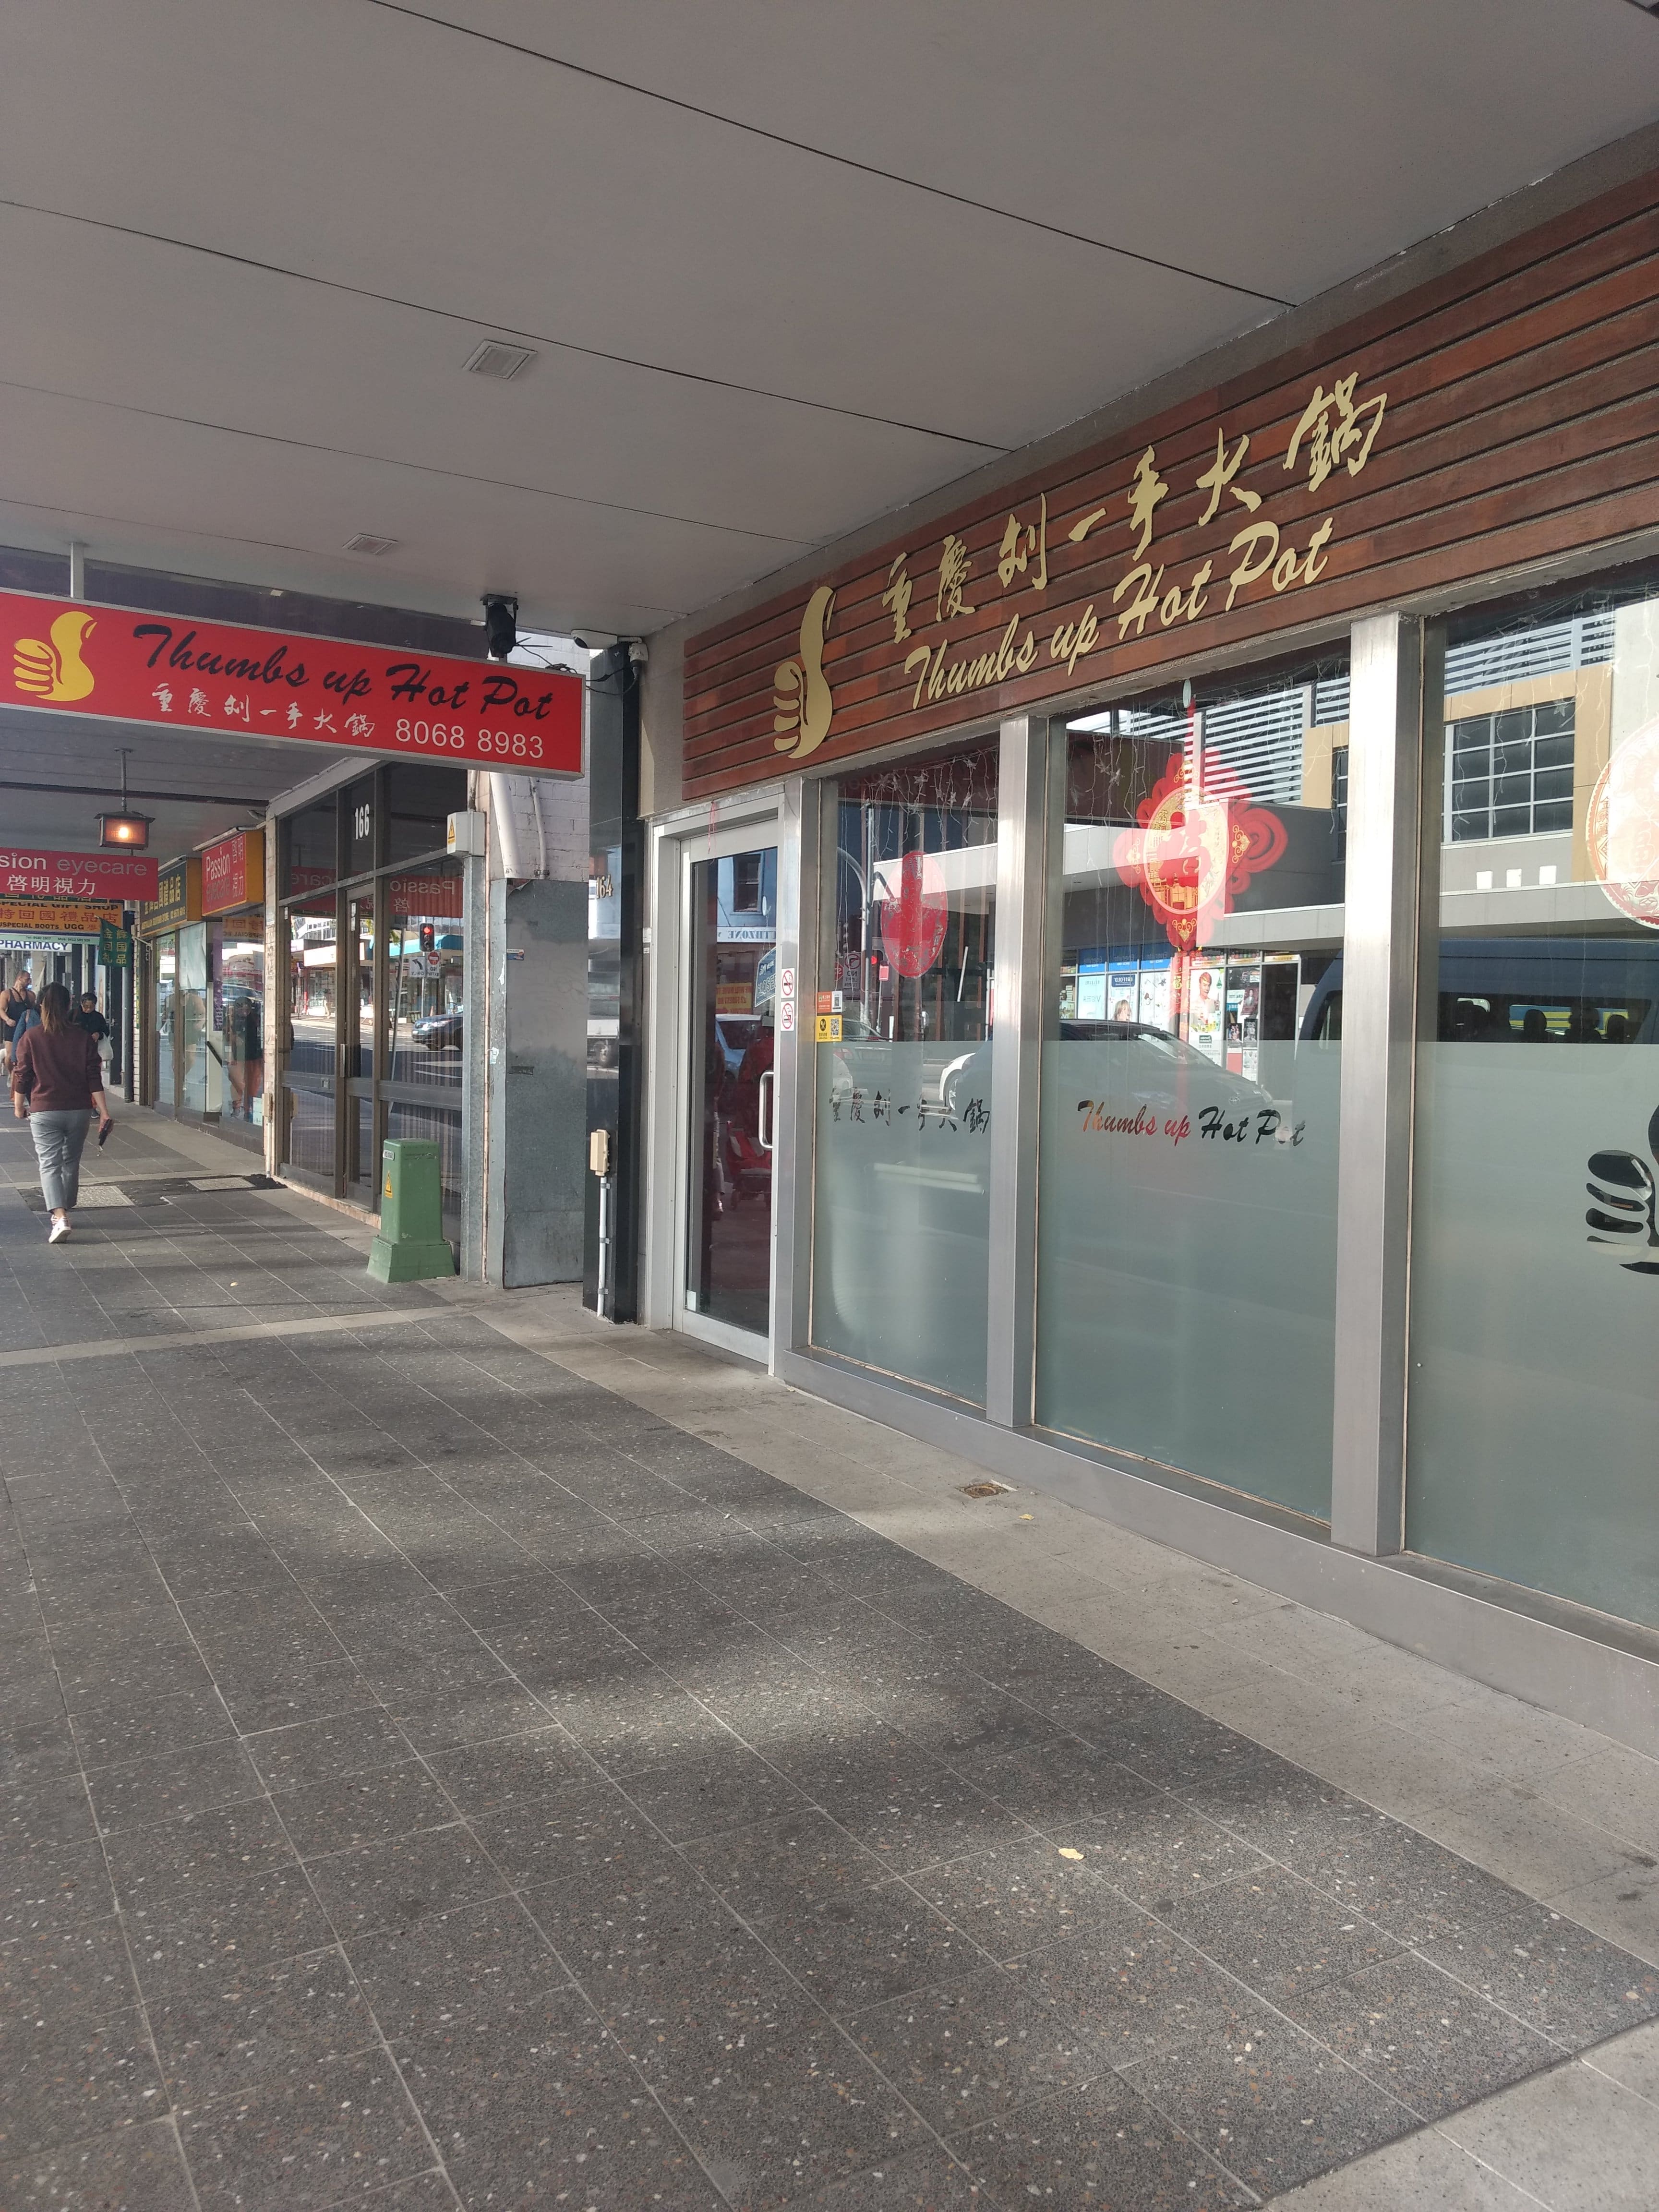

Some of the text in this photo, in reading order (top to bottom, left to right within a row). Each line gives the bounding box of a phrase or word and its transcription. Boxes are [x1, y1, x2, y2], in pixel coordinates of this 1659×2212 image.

[904, 517, 1334, 709] Thumbs up Hot Pot
[133, 624, 554, 720] Thumbs up Hot Pot
[396, 719, 544, 759] 8068 8983
[355, 803, 370, 840] 166
[57, 859, 147, 876] eyecare
[206, 847, 230, 882] Passion
[206, 876, 230, 908] eyecare
[596, 874, 613, 899] 164
[1077, 1100, 1157, 1136] Thumbs
[1164, 1115, 1191, 1147] up
[1199, 1106, 1250, 1142] Hot
